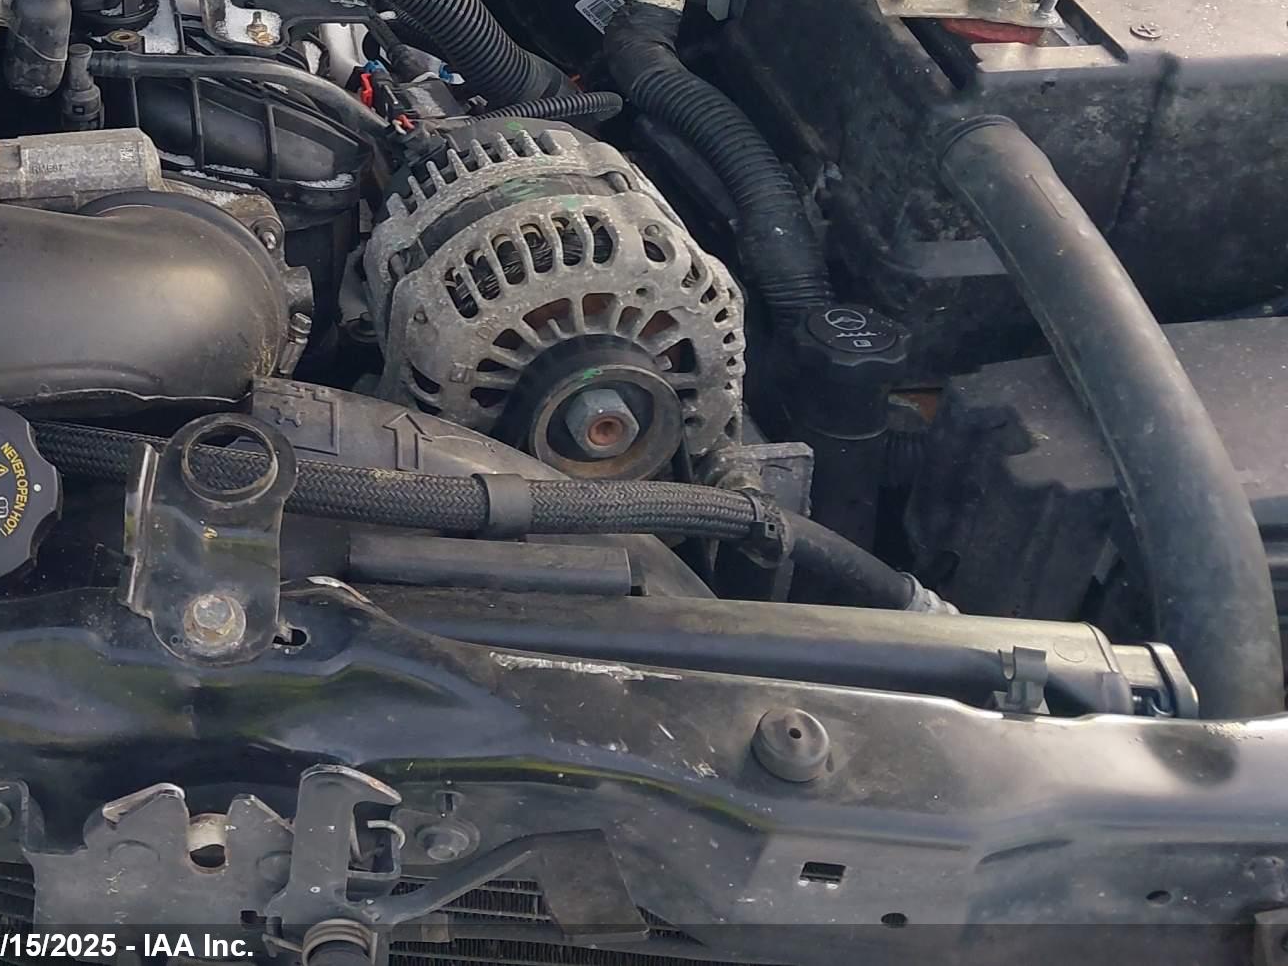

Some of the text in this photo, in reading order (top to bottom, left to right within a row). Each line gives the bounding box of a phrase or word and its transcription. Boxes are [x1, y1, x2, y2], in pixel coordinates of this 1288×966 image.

[0, 442, 28, 537] NEVER OPEN HOT!
